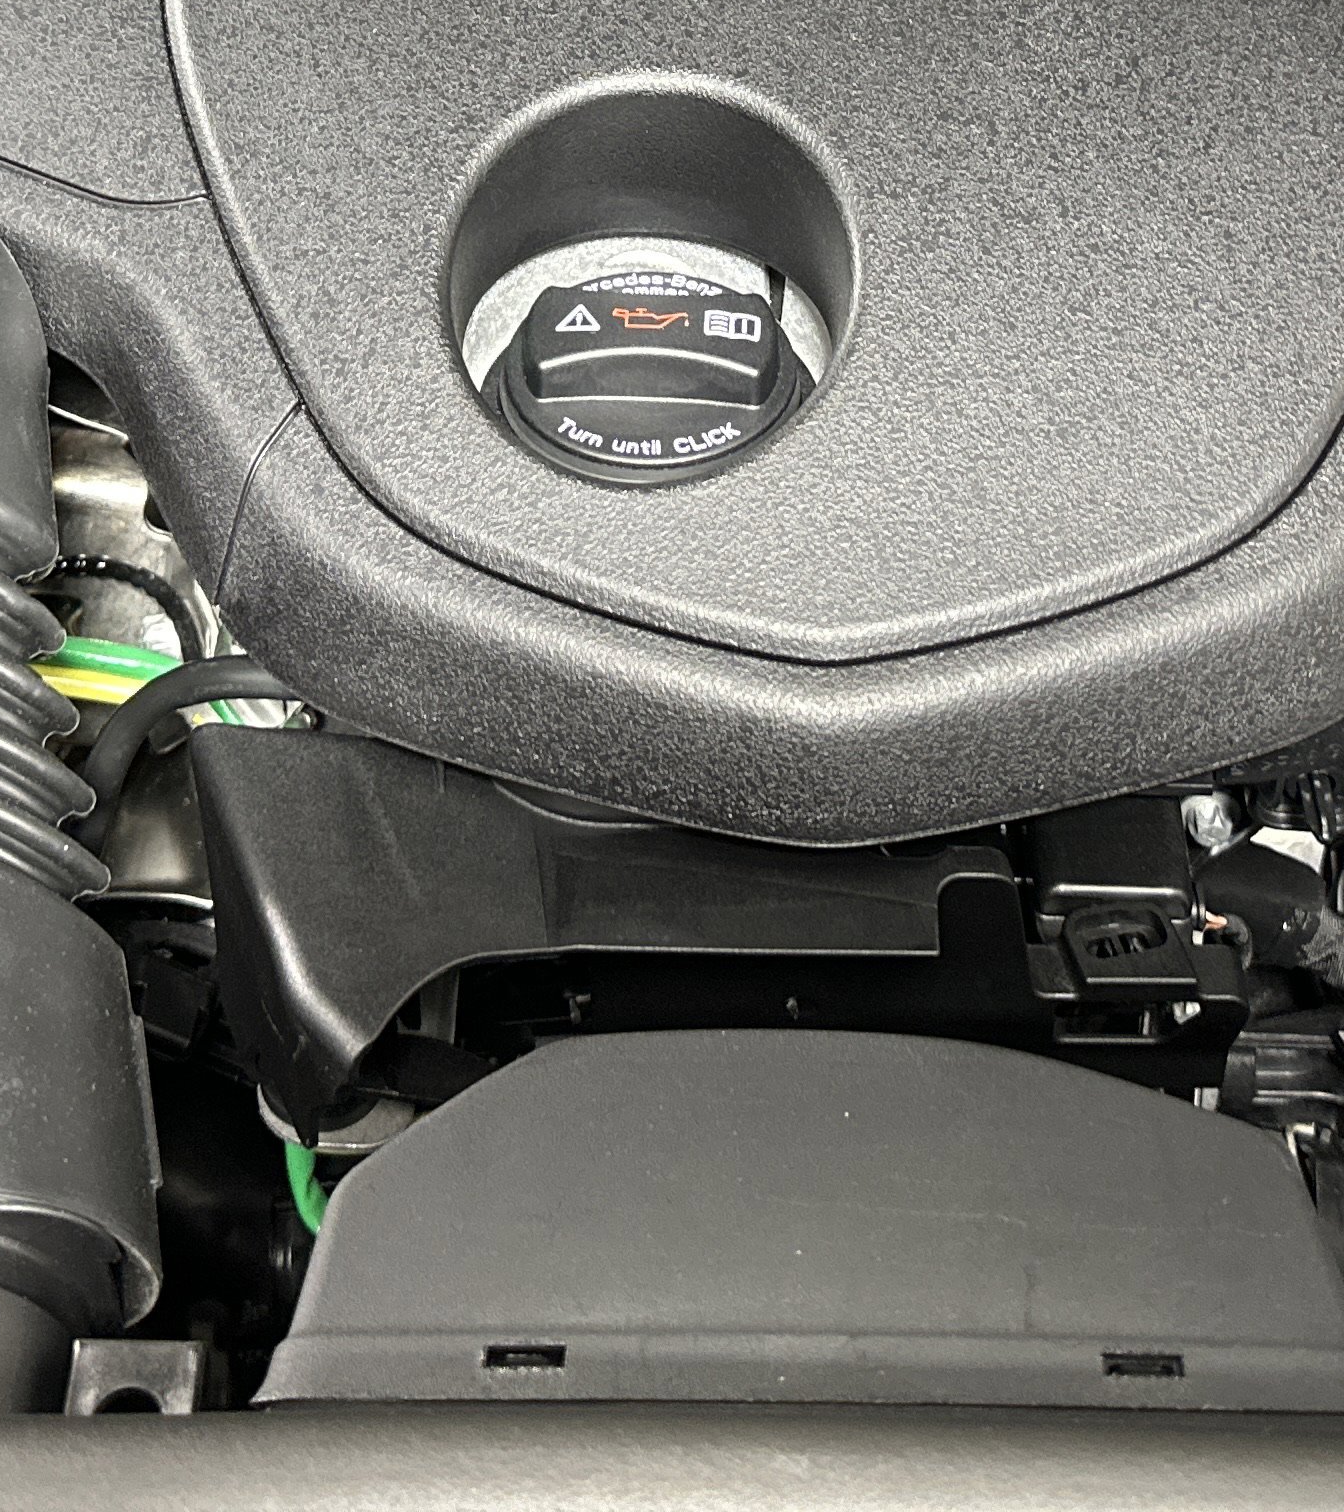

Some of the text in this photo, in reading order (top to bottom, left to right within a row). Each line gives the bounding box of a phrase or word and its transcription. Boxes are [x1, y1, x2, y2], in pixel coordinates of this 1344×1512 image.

[582, 273, 723, 296] ercedes-Benz
[557, 416, 742, 456] Turn until CLICK
